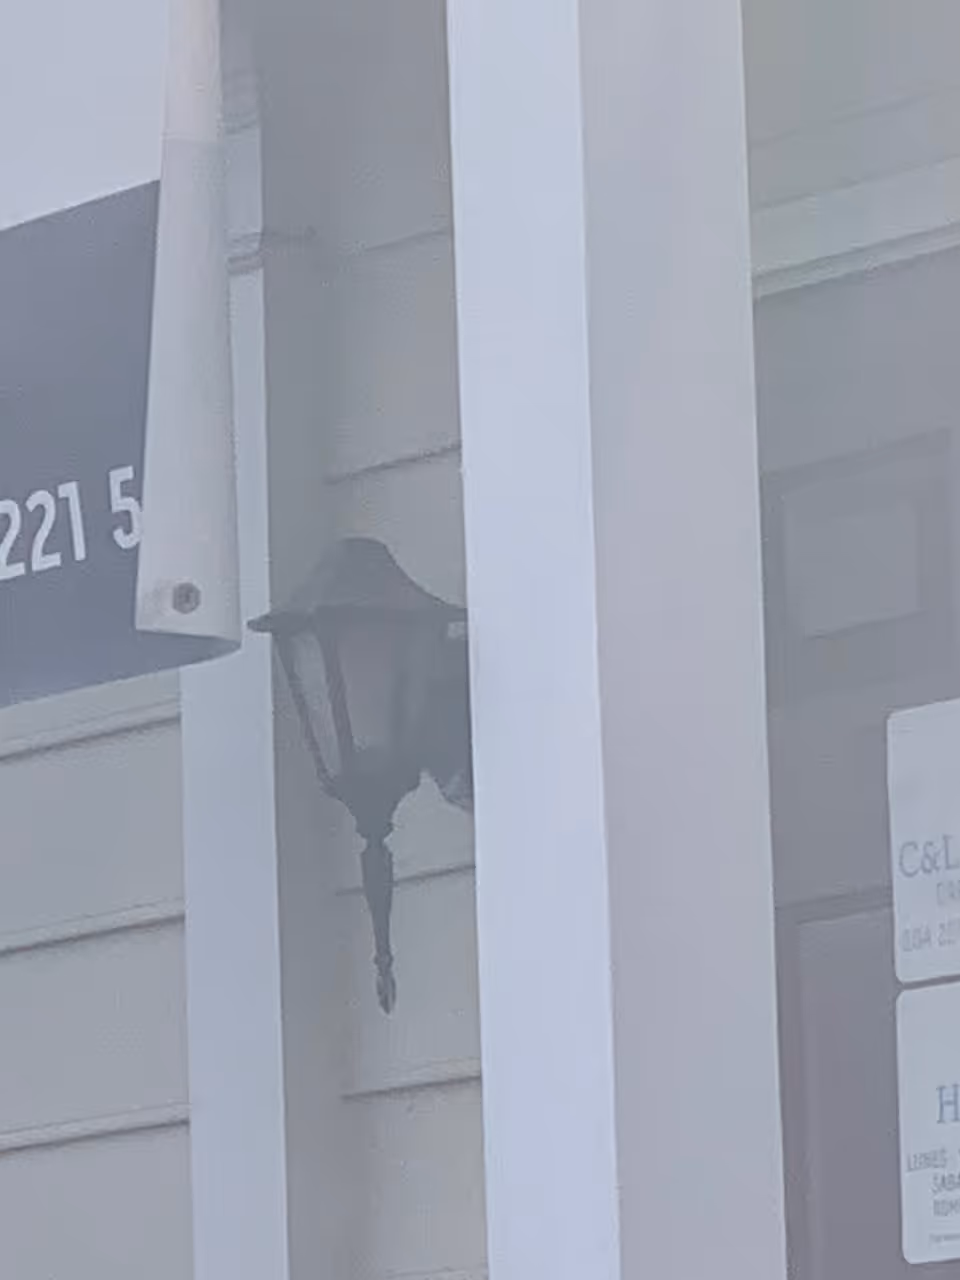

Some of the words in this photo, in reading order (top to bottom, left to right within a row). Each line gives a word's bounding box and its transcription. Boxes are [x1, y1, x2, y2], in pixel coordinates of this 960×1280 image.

[0, 481, 86, 580] 221
[109, 465, 142, 549] 5
[899, 834, 960, 877] C&L
